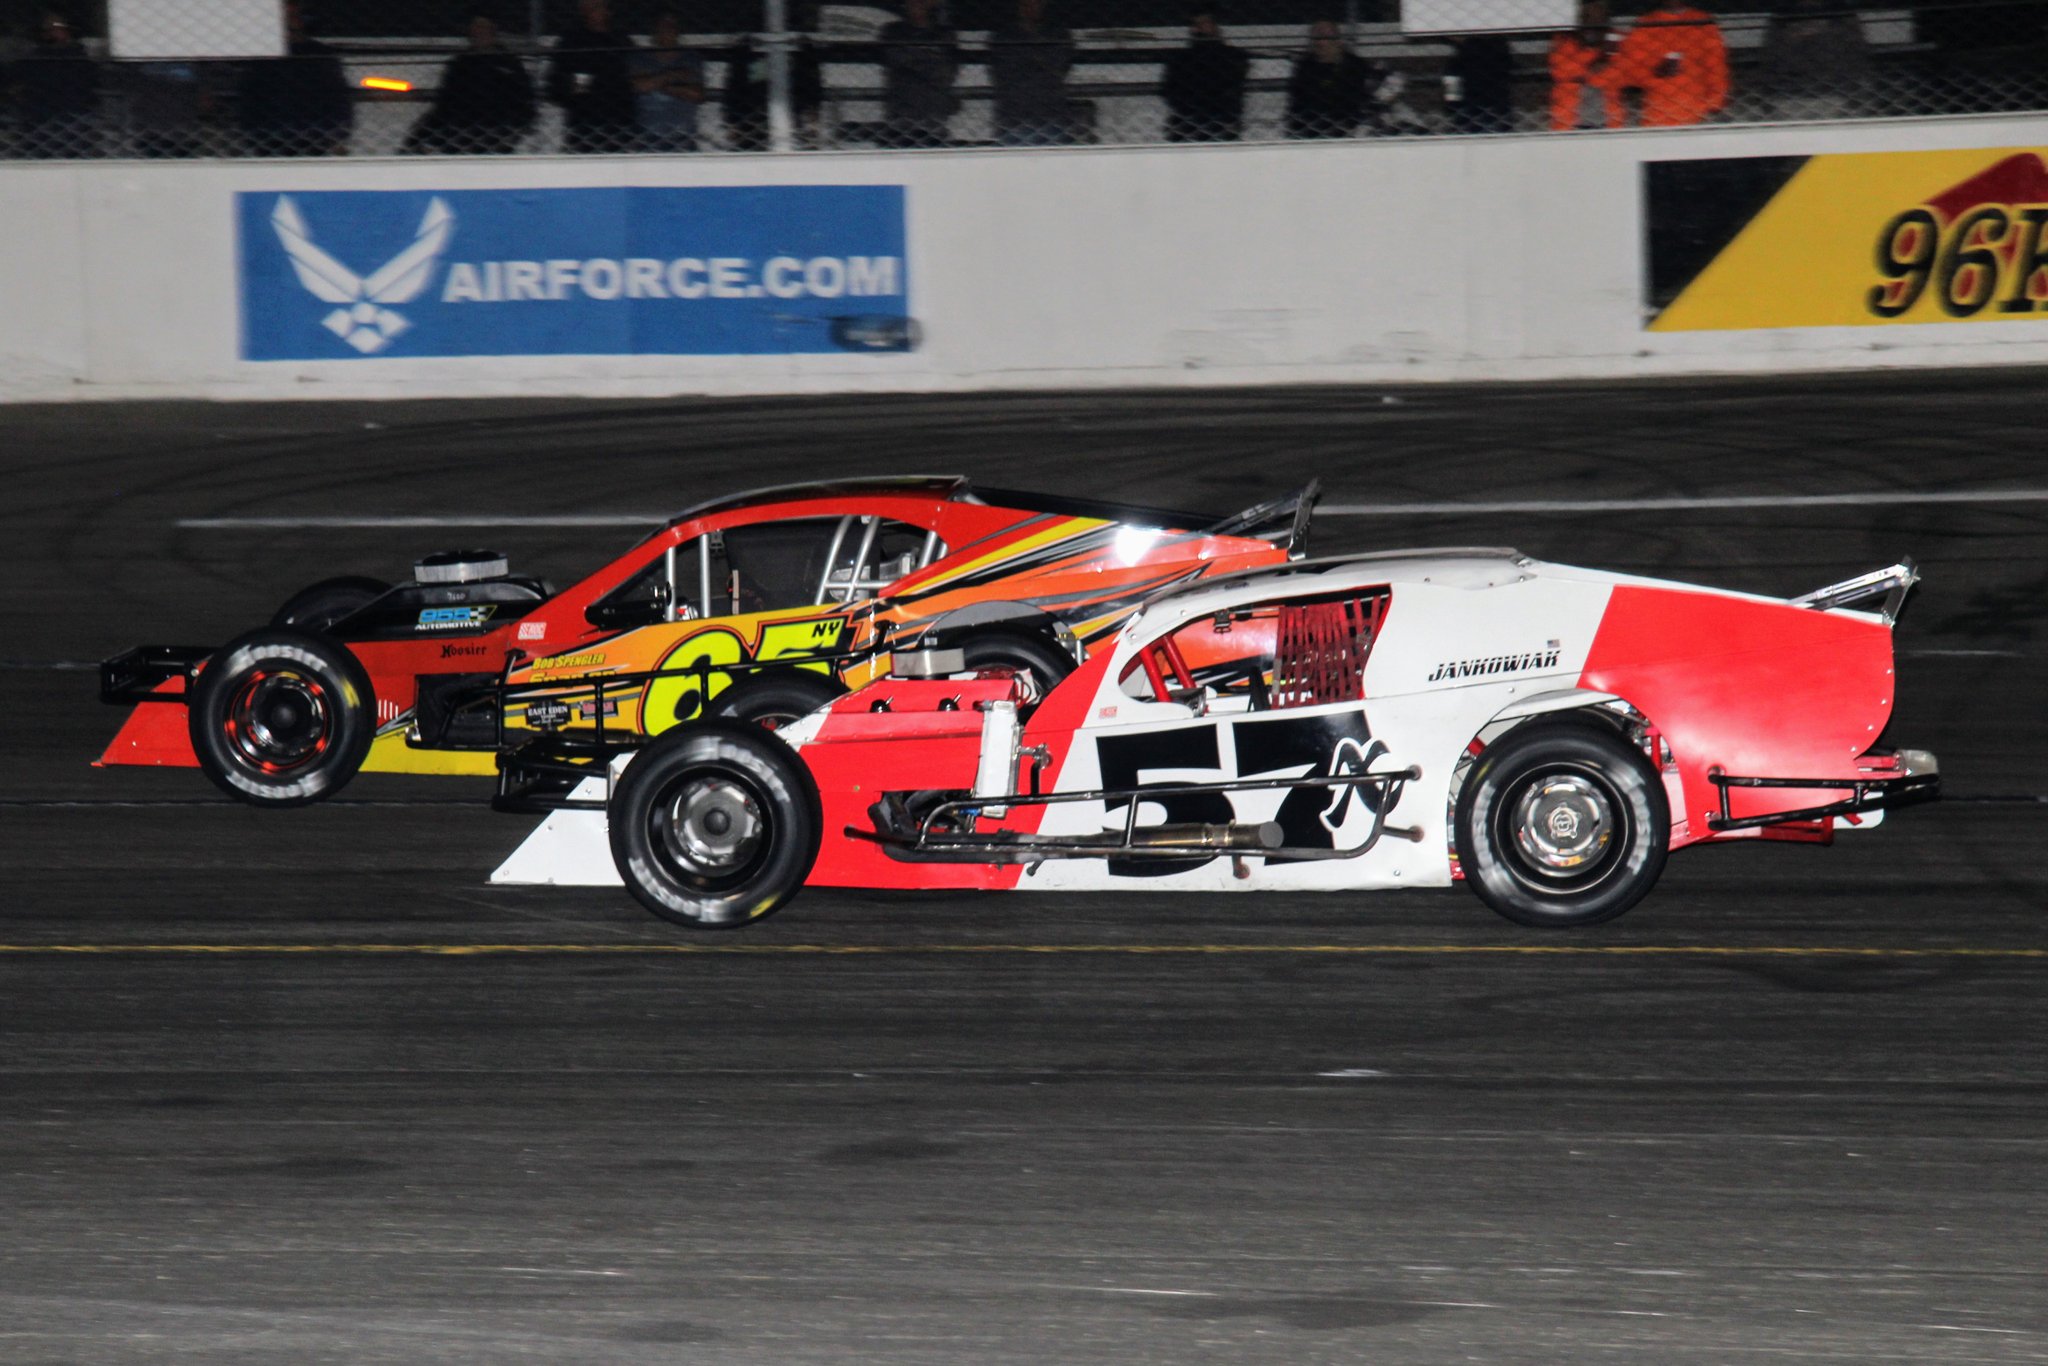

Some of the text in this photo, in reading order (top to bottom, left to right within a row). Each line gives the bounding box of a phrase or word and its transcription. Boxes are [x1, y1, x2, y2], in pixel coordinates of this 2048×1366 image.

[441, 256, 899, 302] AIRFORCE.COM
[415, 621, 481, 630] AUTOMOTIVE
[813, 621, 840, 638] NY
[441, 643, 487, 658] Hoosier
[1428, 650, 1561, 682] JANKOWIAK
[528, 705, 568, 716] EAST EDEN
